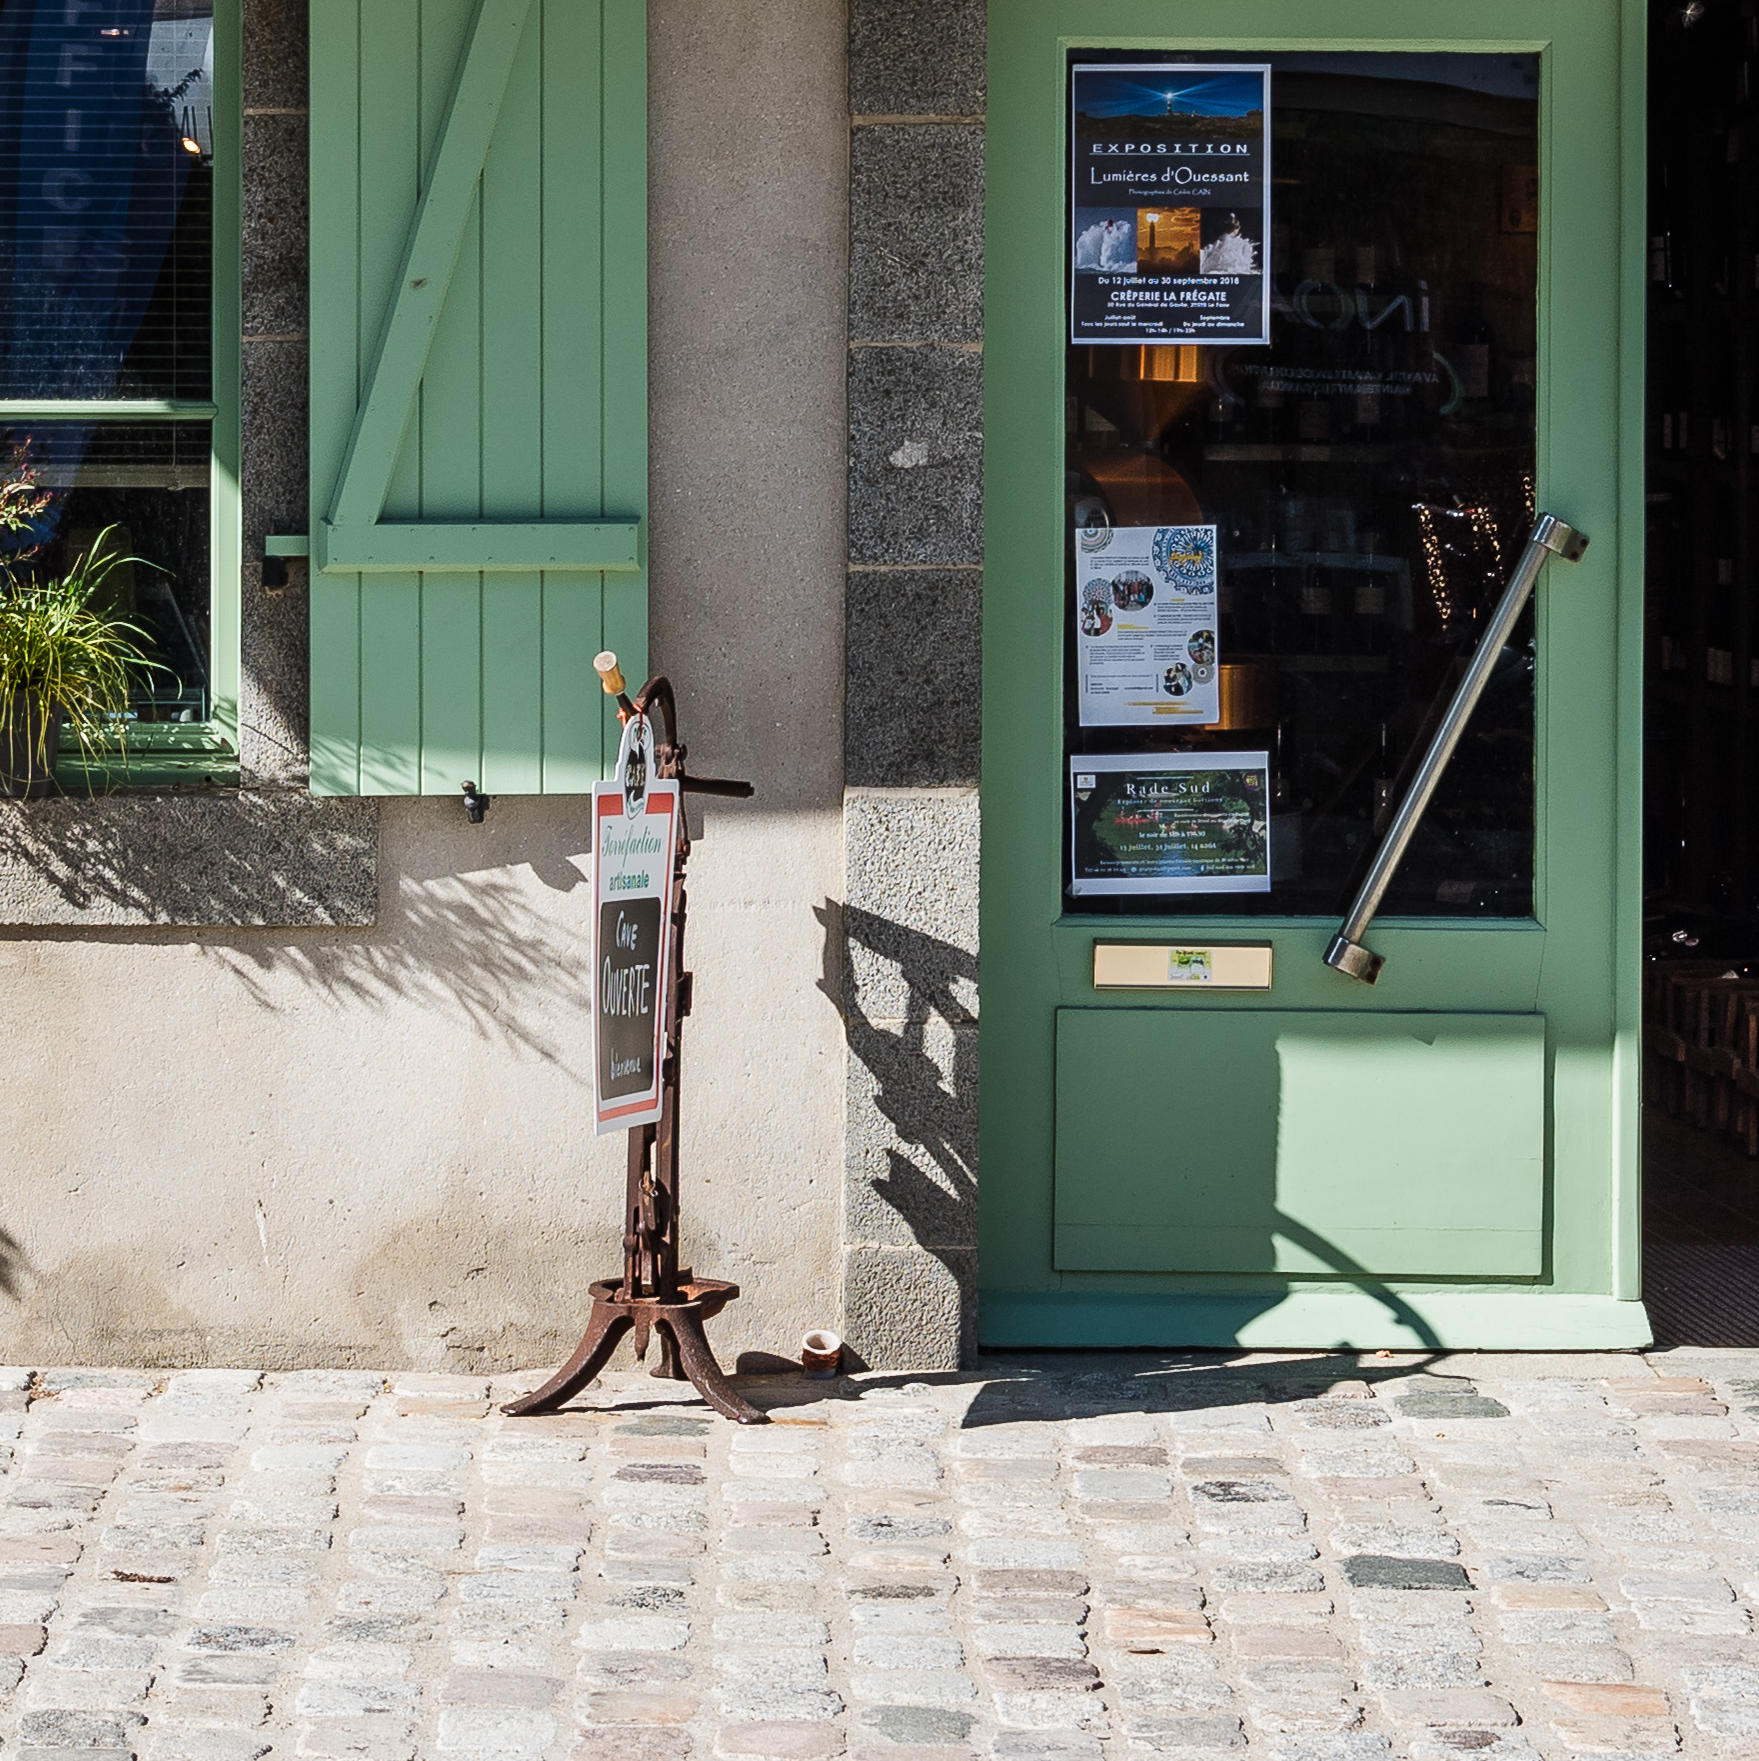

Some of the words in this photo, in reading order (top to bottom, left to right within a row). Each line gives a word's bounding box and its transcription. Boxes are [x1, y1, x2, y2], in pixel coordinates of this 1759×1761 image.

[1092, 143, 1248, 154] EXPOSITION
[1091, 167, 1157, 185] Lumières
[1161, 167, 1250, 185] d'Ouessant
[1123, 277, 1146, 286] juillet
[1173, 277, 1218, 286] septembre
[1110, 290, 1160, 301] CRÊPERIE
[1163, 291, 1176, 301] LA
[1179, 289, 1227, 301] FRÉGATE
[1126, 783, 1169, 795] Rade
[1178, 781, 1210, 794] Sud
[609, 869, 650, 891] artisanale
[602, 955, 650, 1018] OUVERTE
